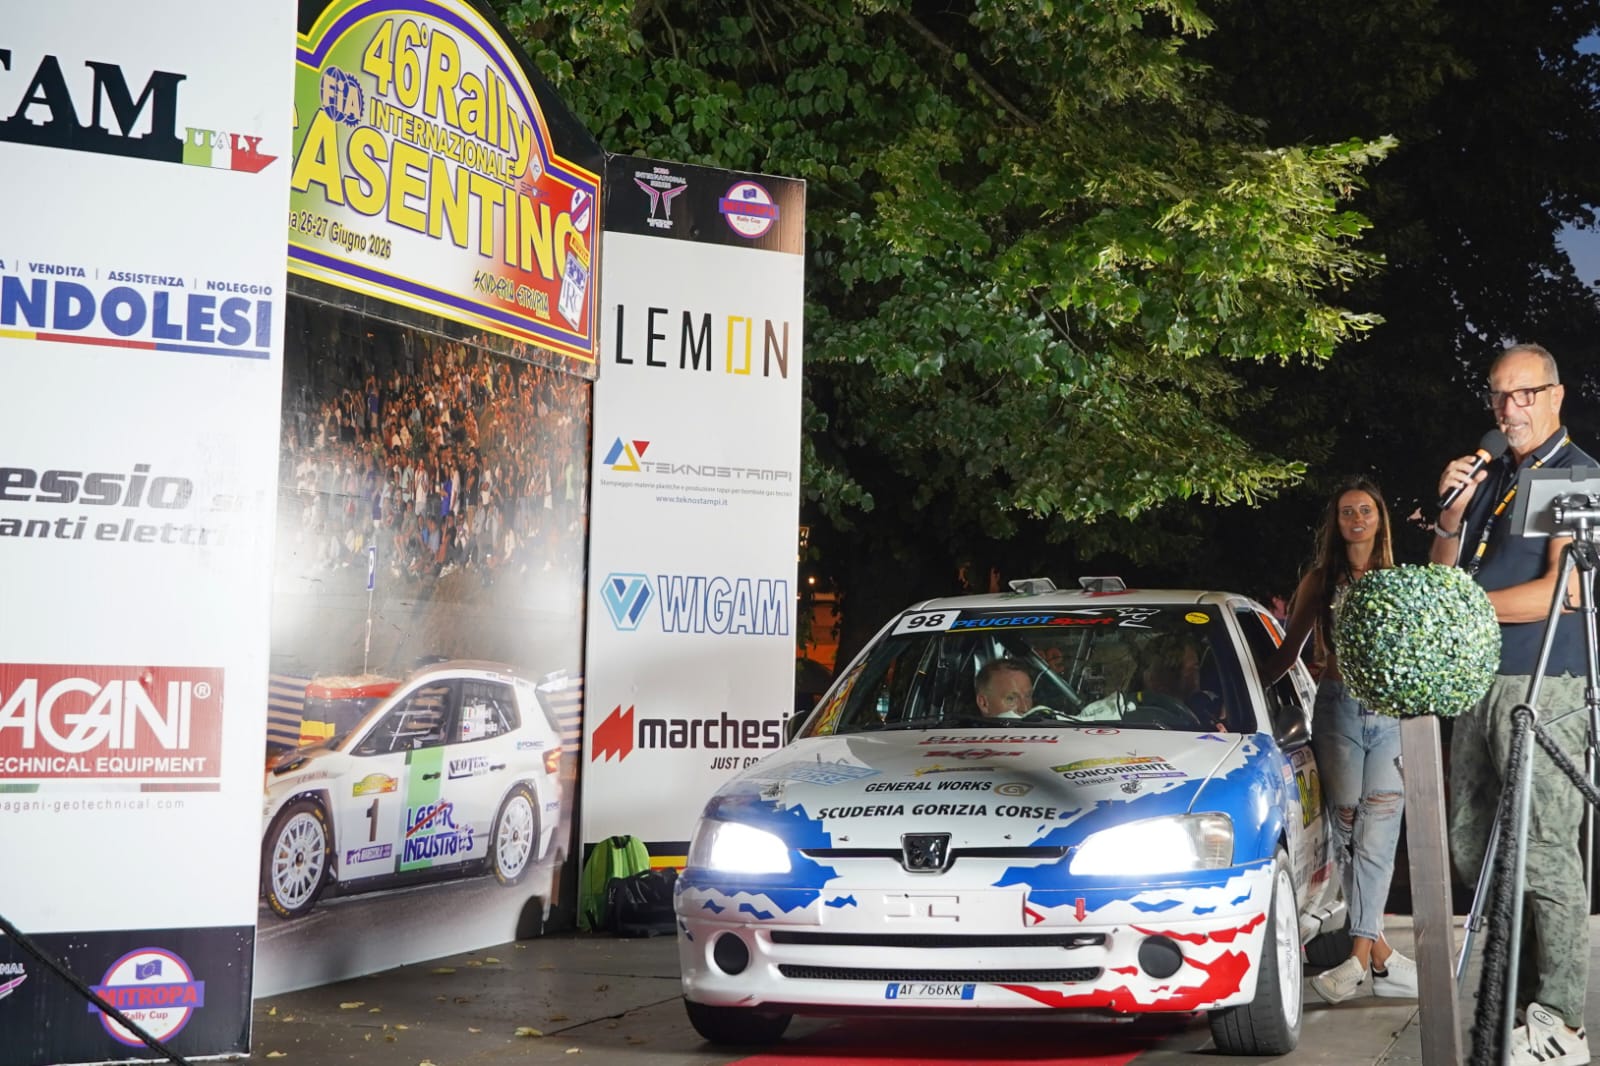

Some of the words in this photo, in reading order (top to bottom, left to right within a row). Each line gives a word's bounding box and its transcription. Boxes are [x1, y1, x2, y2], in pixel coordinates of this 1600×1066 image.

[0, 49, 187, 140] AM
[423, 28, 533, 178] Rally
[184, 127, 263, 156] ITALY
[369, 97, 517, 186] INTERNAZIONALE
[291, 103, 588, 283] ASENTINO
[301, 212, 328, 238] 26-27
[329, 221, 367, 254] Giugno
[369, 233, 392, 259] 2026
[29, 262, 86, 278] VENDITA
[108, 271, 185, 288] ASSISTENZA
[206, 280, 273, 296] NOLEGGIO
[1, 275, 272, 348] NDOLESI
[641, 461, 792, 482] TEKNOSTAMPI
[656, 495, 728, 506] www.teknostampi.it
[657, 575, 789, 636] WIGAM
[907, 613, 945, 629] 98
[952, 616, 1054, 629] PEUGEOT
[1049, 616, 1114, 627] Sport
[638, 712, 789, 748] marchesi
[96, 757, 207, 773] EQUIPMENT
[711, 757, 740, 770] JUST
[1063, 763, 1176, 780] CONCORRENTE
[865, 782, 932, 793] GENERAL
[937, 781, 993, 791] WORKS
[0, 799, 184, 813] agani-geotechnical.com
[817, 805, 904, 820] SCUDERIA
[912, 804, 987, 816] GORIZIA
[995, 805, 1057, 820] CORSE
[366, 798, 379, 842] 1
[96, 986, 198, 1007] MITROPA
[900, 984, 913, 995] AT
[920, 984, 962, 995] 766KK
[149, 1010, 168, 1020] Cup
